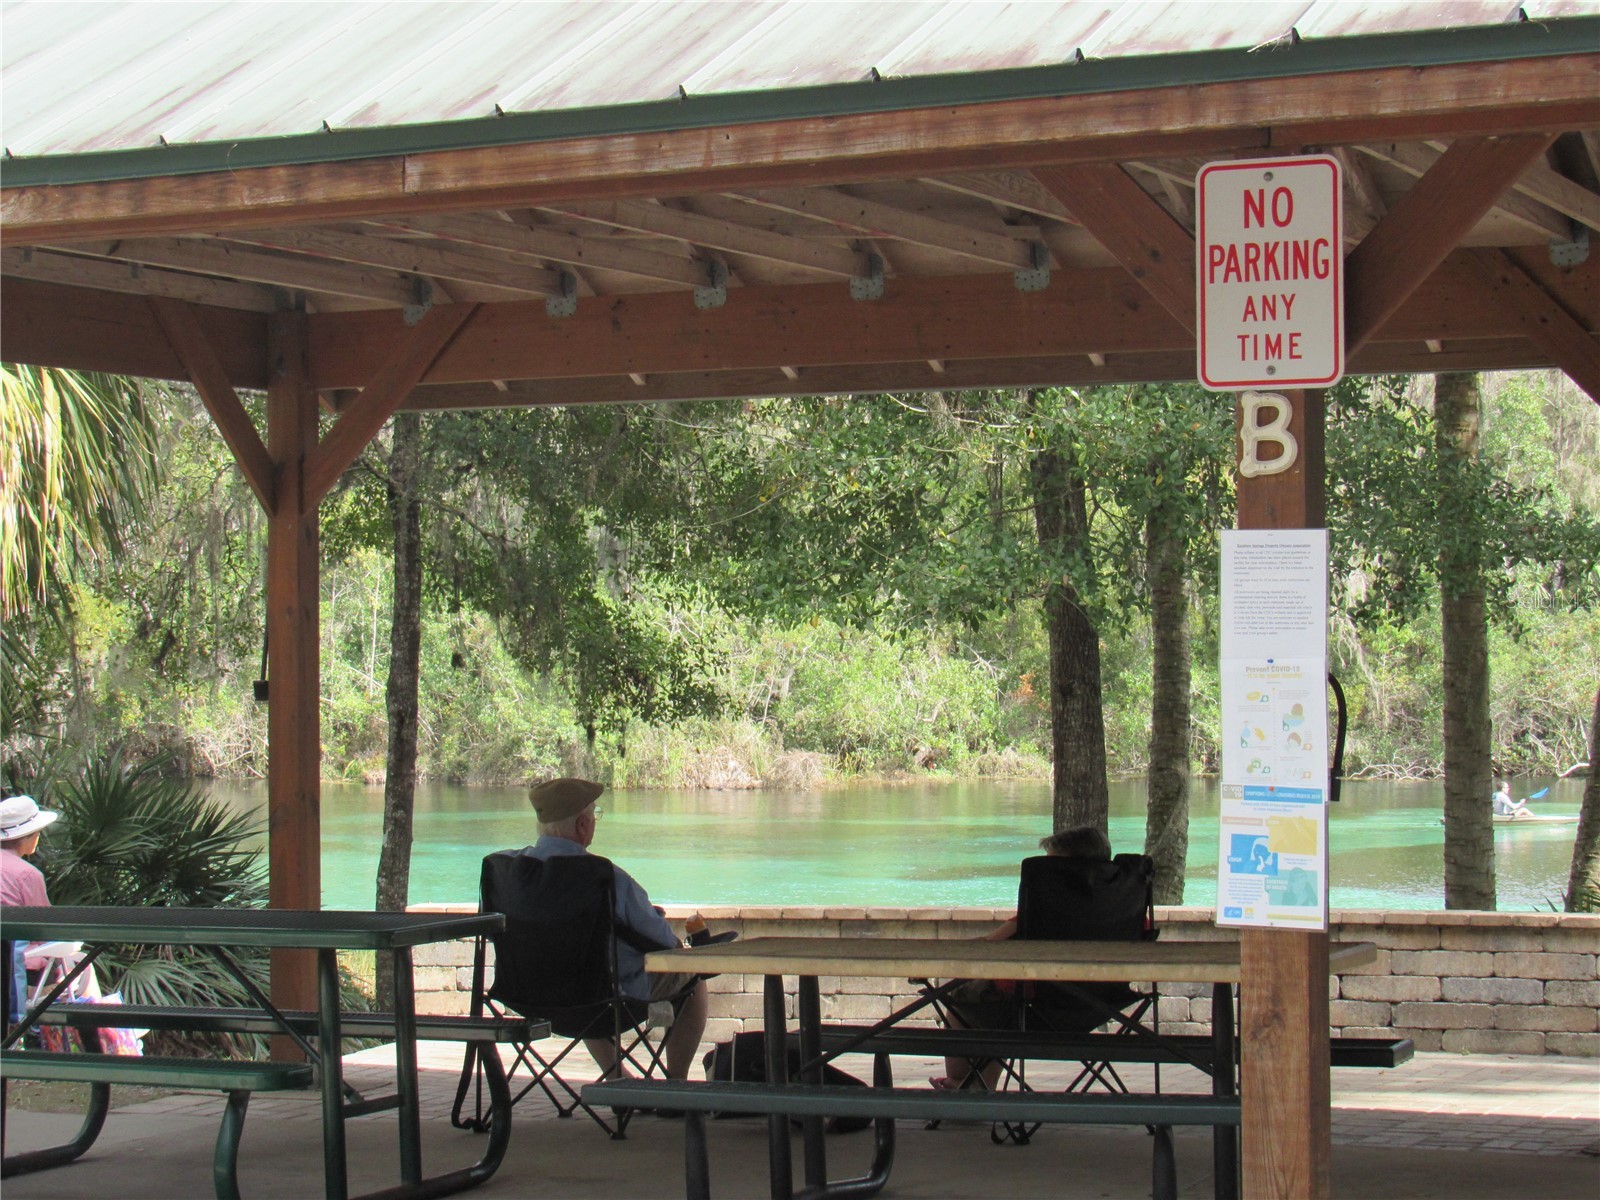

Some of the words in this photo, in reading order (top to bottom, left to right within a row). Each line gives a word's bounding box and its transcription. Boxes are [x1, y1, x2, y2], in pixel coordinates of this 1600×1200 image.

[1243, 186, 1294, 229] NO
[1208, 237, 1330, 284] PARKING
[1242, 293, 1296, 322] ANY
[1236, 332, 1302, 361] TIME
[1240, 390, 1298, 478] B
[1245, 665, 1270, 673] Prevent
